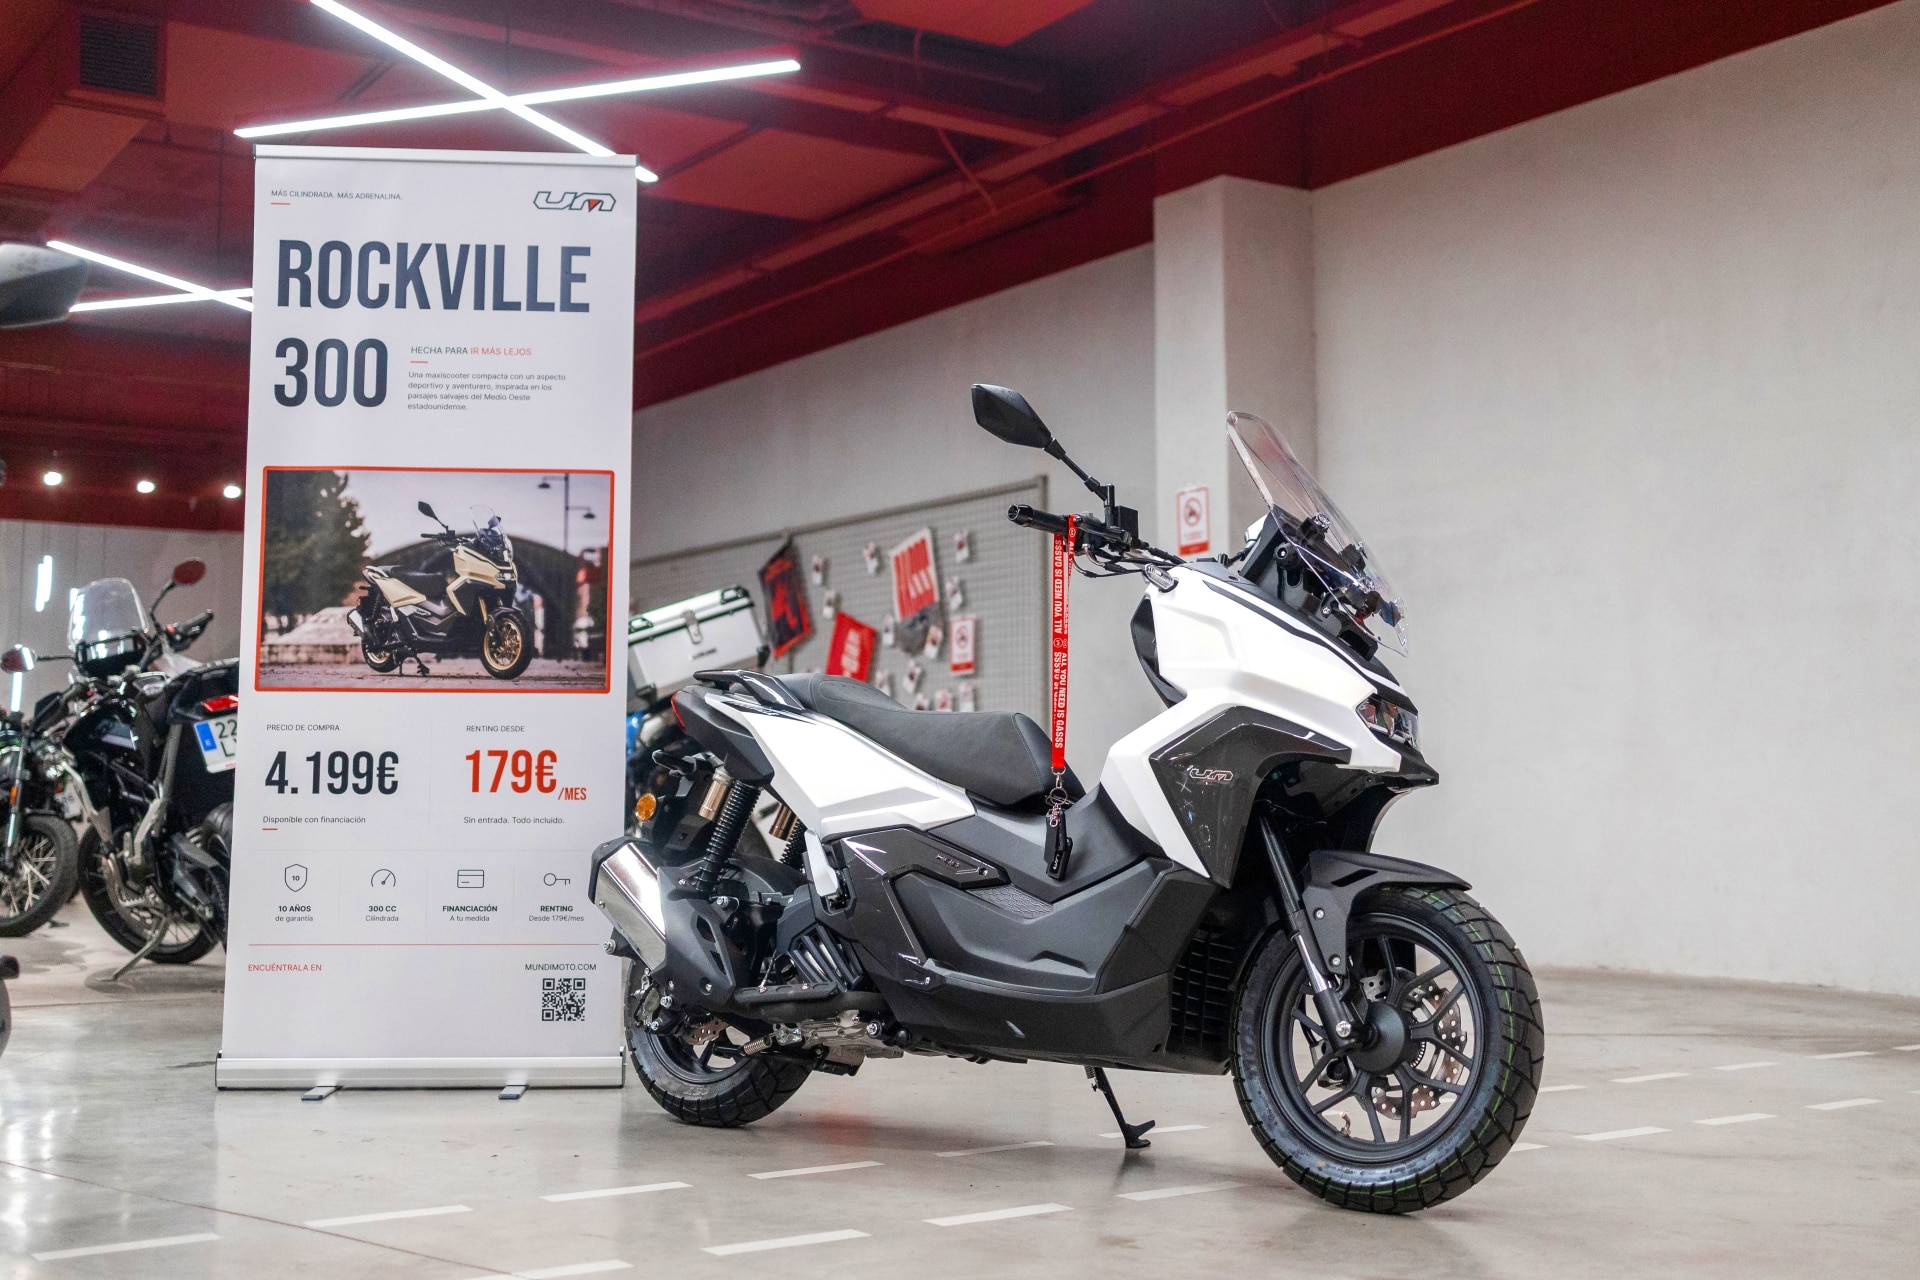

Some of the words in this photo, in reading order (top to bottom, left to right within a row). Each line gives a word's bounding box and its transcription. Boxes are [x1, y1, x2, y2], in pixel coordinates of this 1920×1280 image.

[271, 189, 288, 197] MÁS
[289, 190, 335, 199] CILINDRADA.
[337, 191, 354, 199] MÁS
[355, 192, 403, 200] ADRENALINA.
[277, 239, 591, 313] ROCKVILLE
[410, 346, 443, 355] HECHA
[445, 346, 469, 355] PARA
[470, 347, 479, 355] IR
[481, 346, 502, 356] MÁS
[503, 347, 532, 356] LEJOS
[274, 337, 388, 408] 300
[408, 371, 424, 379] Una
[425, 372, 470, 380] maxiscooter
[471, 372, 508, 382] compacta
[536, 374, 566, 382] aspecto
[407, 382, 443, 391] deportivo
[451, 383, 493, 391] aventurero,
[495, 383, 529, 392] inspirada
[541, 383, 552, 391] los
[407, 392, 438, 402] paisajes
[439, 393, 469, 402] salvajes
[470, 393, 482, 401] del
[484, 393, 507, 401] Medio
[508, 393, 531, 401] Oeste
[407, 402, 468, 411] estadounidense.
[1055, 569, 1063, 578] IS
[1054, 578, 1063, 600] NEED
[1054, 600, 1063, 618] YOU
[1054, 619, 1063, 634] ALL
[1059, 668, 1067, 686] YOU
[1058, 687, 1066, 709] NEED
[1056, 709, 1065, 718] IS
[266, 723, 294, 732] PRECIO
[295, 724, 306, 732] DE
[307, 724, 340, 732] COMPRA
[466, 725, 499, 733] RENTING
[500, 725, 525, 733] DESDE
[264, 750, 399, 795] 4.199€
[465, 749, 558, 794] 179€
[263, 815, 303, 825] Disponible
[320, 815, 366, 824] financiación
[463, 816, 476, 824] Sin
[477, 816, 510, 824] entrada.
[512, 816, 532, 824] Todo
[533, 816, 565, 824] incluido.
[289, 903, 312, 912] AÑOS
[442, 903, 498, 912] FINANCIACIÓN
[275, 914, 285, 922] de
[286, 914, 314, 923] garantía
[365, 914, 399, 922] Cilindrada
[449, 914, 456, 922] A
[456, 914, 464, 922] tu
[464, 914, 490, 922] medida
[529, 914, 551, 922] Desde
[552, 914, 585, 922] 179€/mes
[248, 962, 309, 971] ENCUÉNTRALA
[310, 963, 323, 971] EN
[525, 963, 597, 971] MUNDIMOTO.COM
